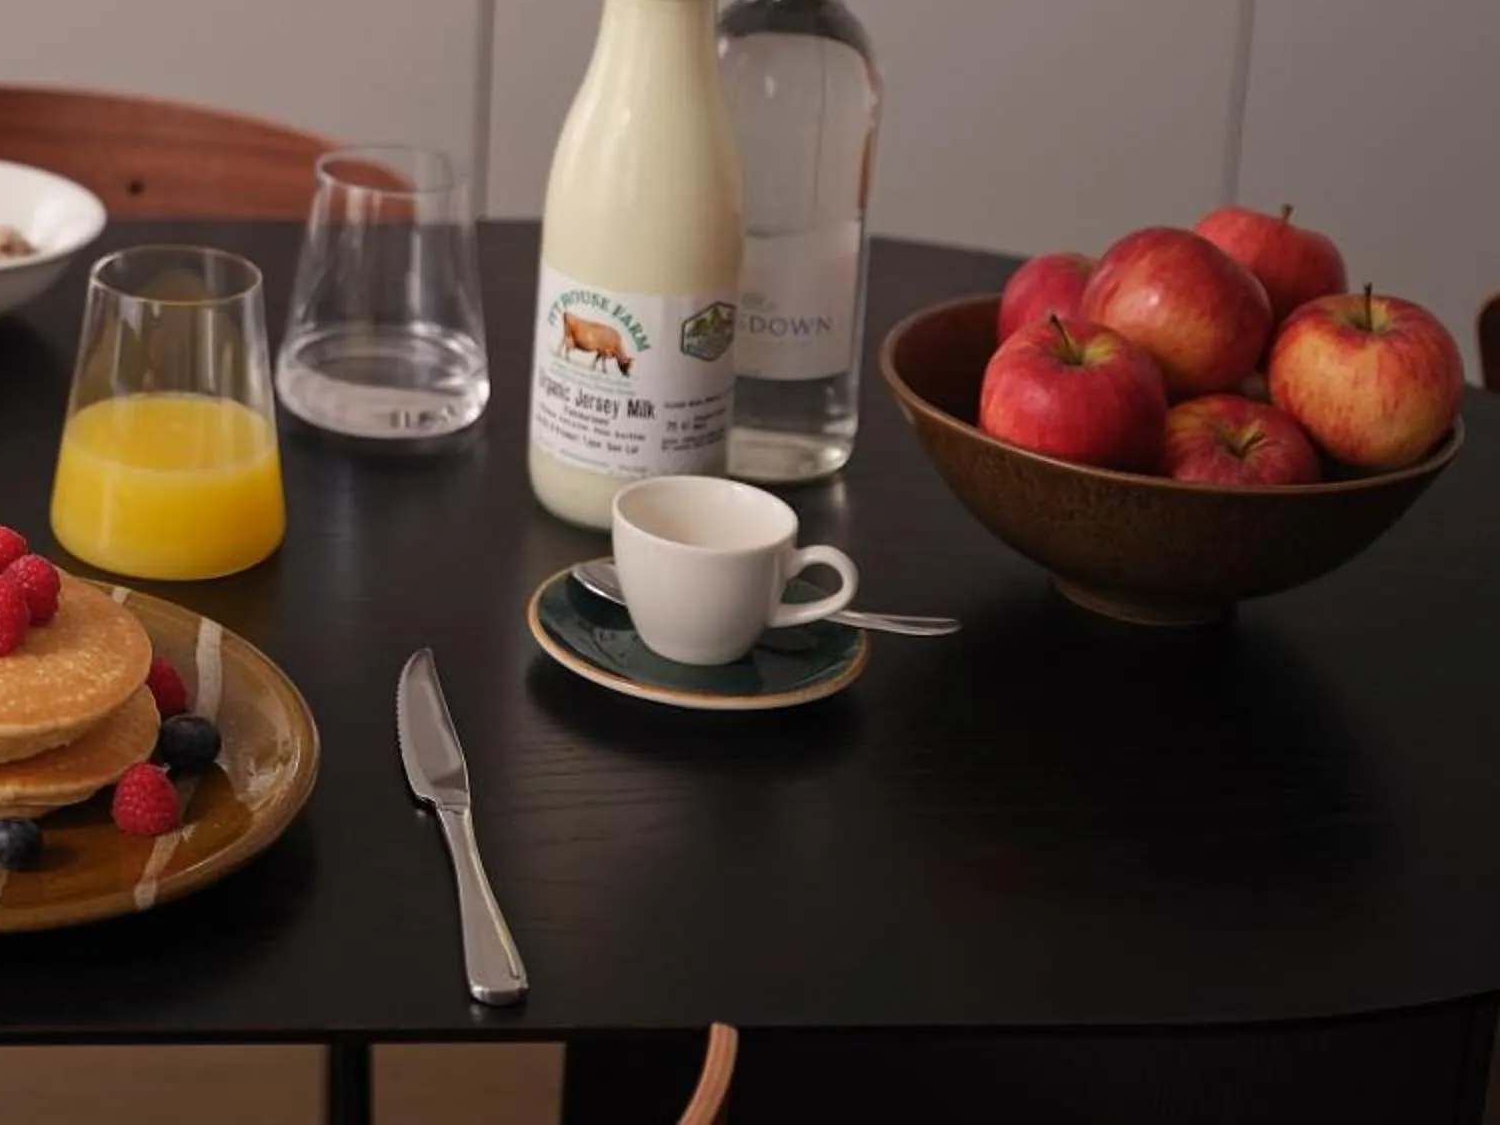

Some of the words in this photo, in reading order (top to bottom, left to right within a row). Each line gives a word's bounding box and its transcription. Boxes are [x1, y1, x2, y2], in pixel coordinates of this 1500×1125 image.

[560, 290, 612, 313] HOUSE
[611, 303, 652, 353] FARM
[574, 386, 620, 420] Jersey
[627, 398, 656, 420] Milk
